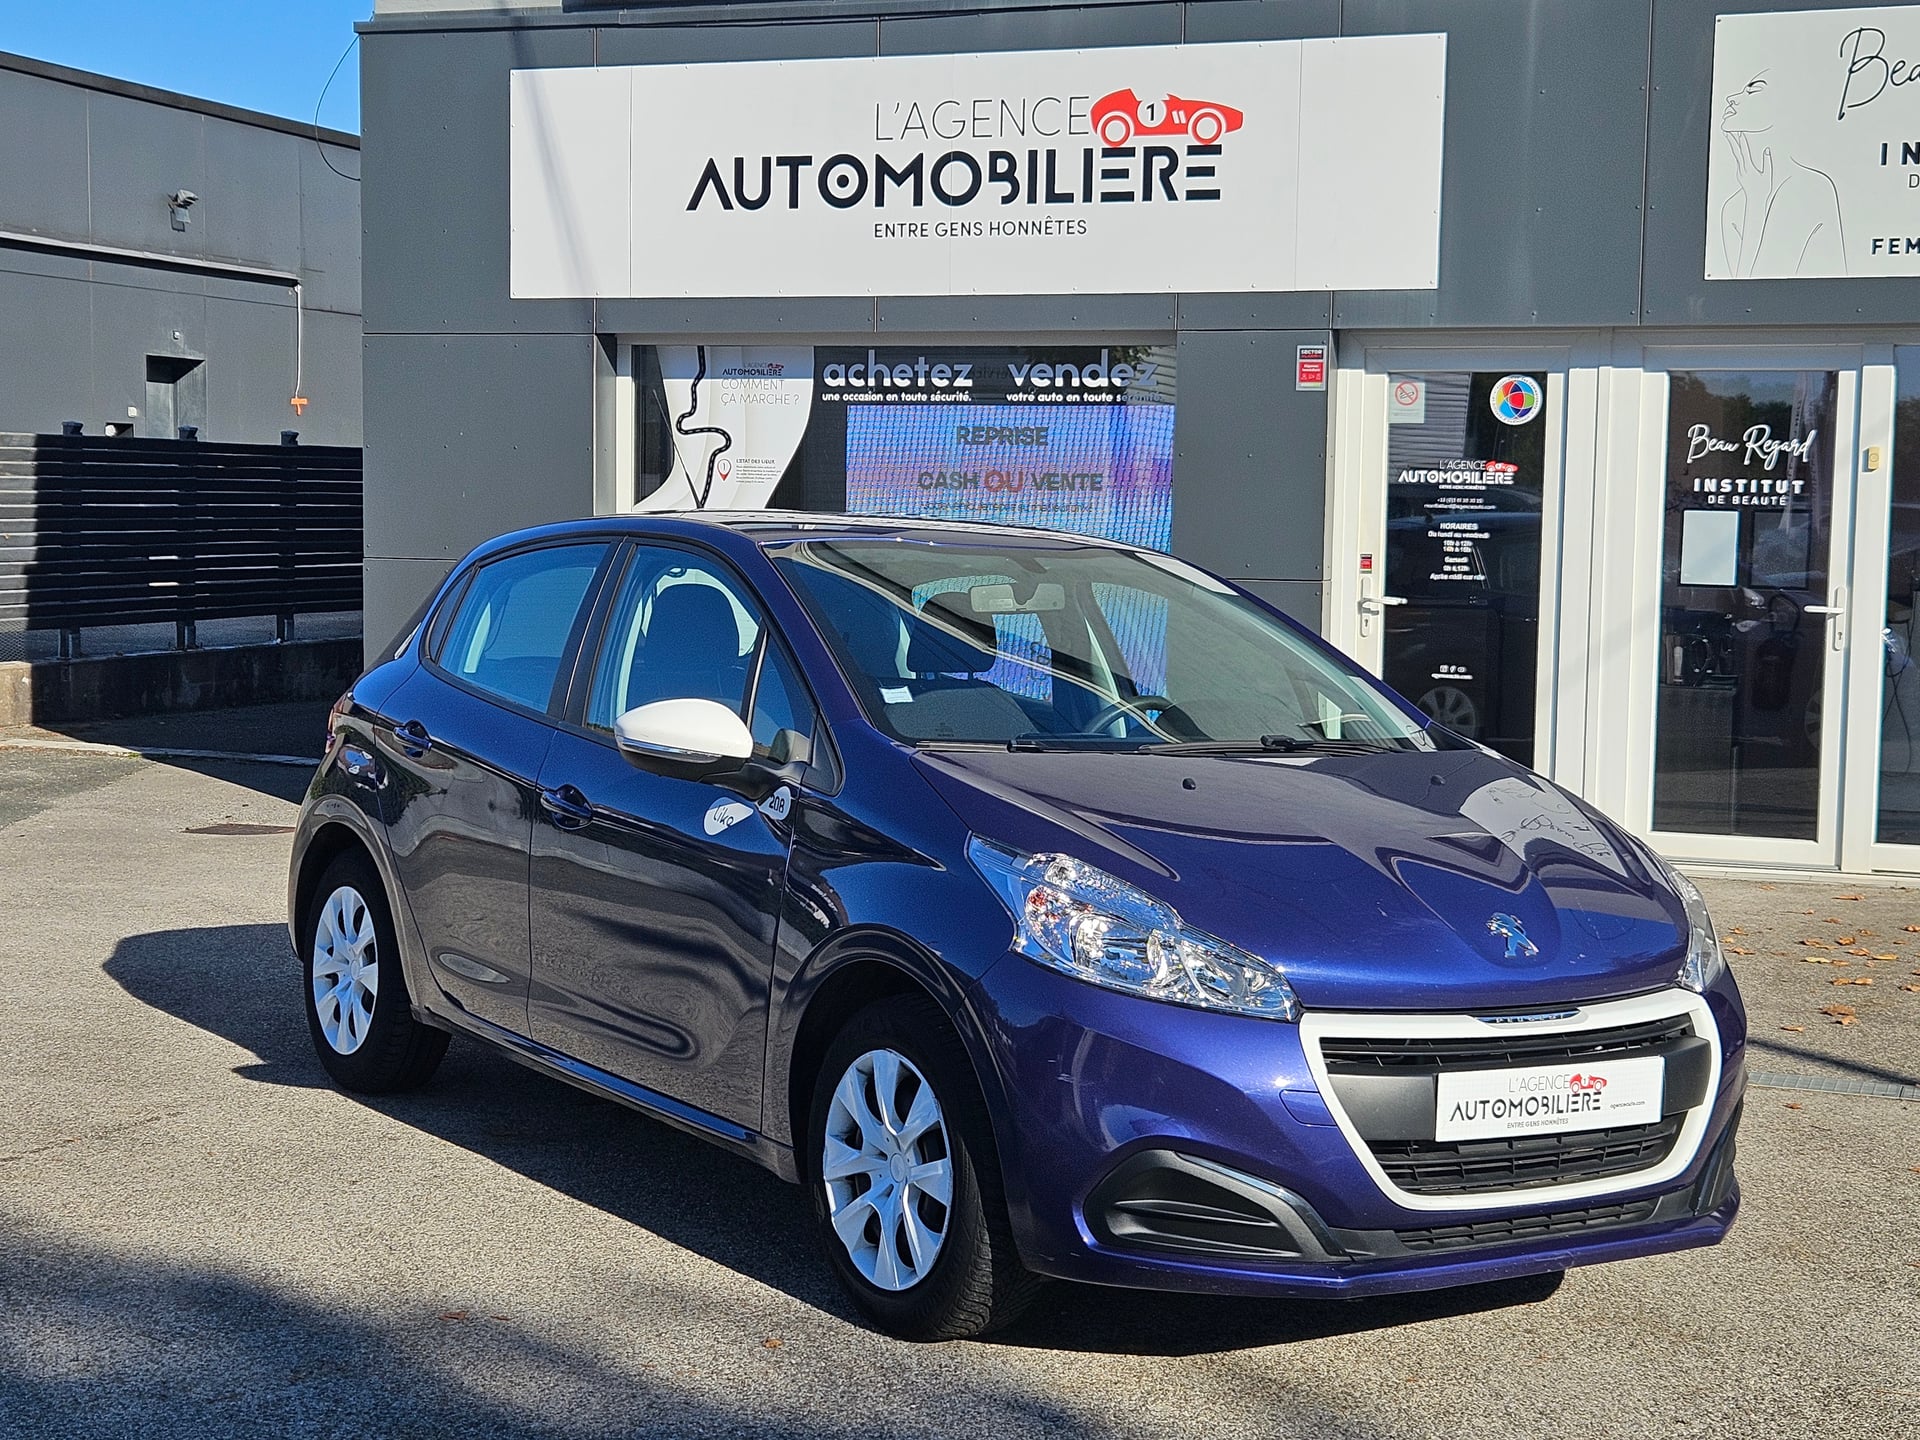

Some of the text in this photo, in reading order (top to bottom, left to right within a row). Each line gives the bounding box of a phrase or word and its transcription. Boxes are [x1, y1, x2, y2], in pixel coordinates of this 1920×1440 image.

[873, 95, 1090, 141] L'AGENCE
[873, 216, 1088, 239] ENTRE GENS HONNÊTES
[822, 349, 974, 388] achetez
[1007, 348, 1159, 388] vendez
[721, 378, 785, 391] COMMENT
[720, 392, 800, 406] ÇA MARCHE ?
[821, 390, 972, 401] une occasion en toute sécurité.
[1006, 391, 1035, 402] votre
[1037, 391, 1064, 402] auto
[1066, 393, 1080, 402] en
[1083, 391, 1113, 402] toute
[956, 426, 1049, 446] REPRISE
[1686, 423, 1818, 471] Beau Regard
[1439, 460, 1487, 470] L'AGENCE
[917, 470, 1103, 493] CASH OU VENTE
[1693, 477, 1806, 495] INSTITUT
[1707, 493, 1789, 506] DE BEAUTÉ
[1440, 522, 1479, 530] HORAIRES
[768, 795, 786, 814] 208
[1508, 1073, 1571, 1093] L'AGENCE
